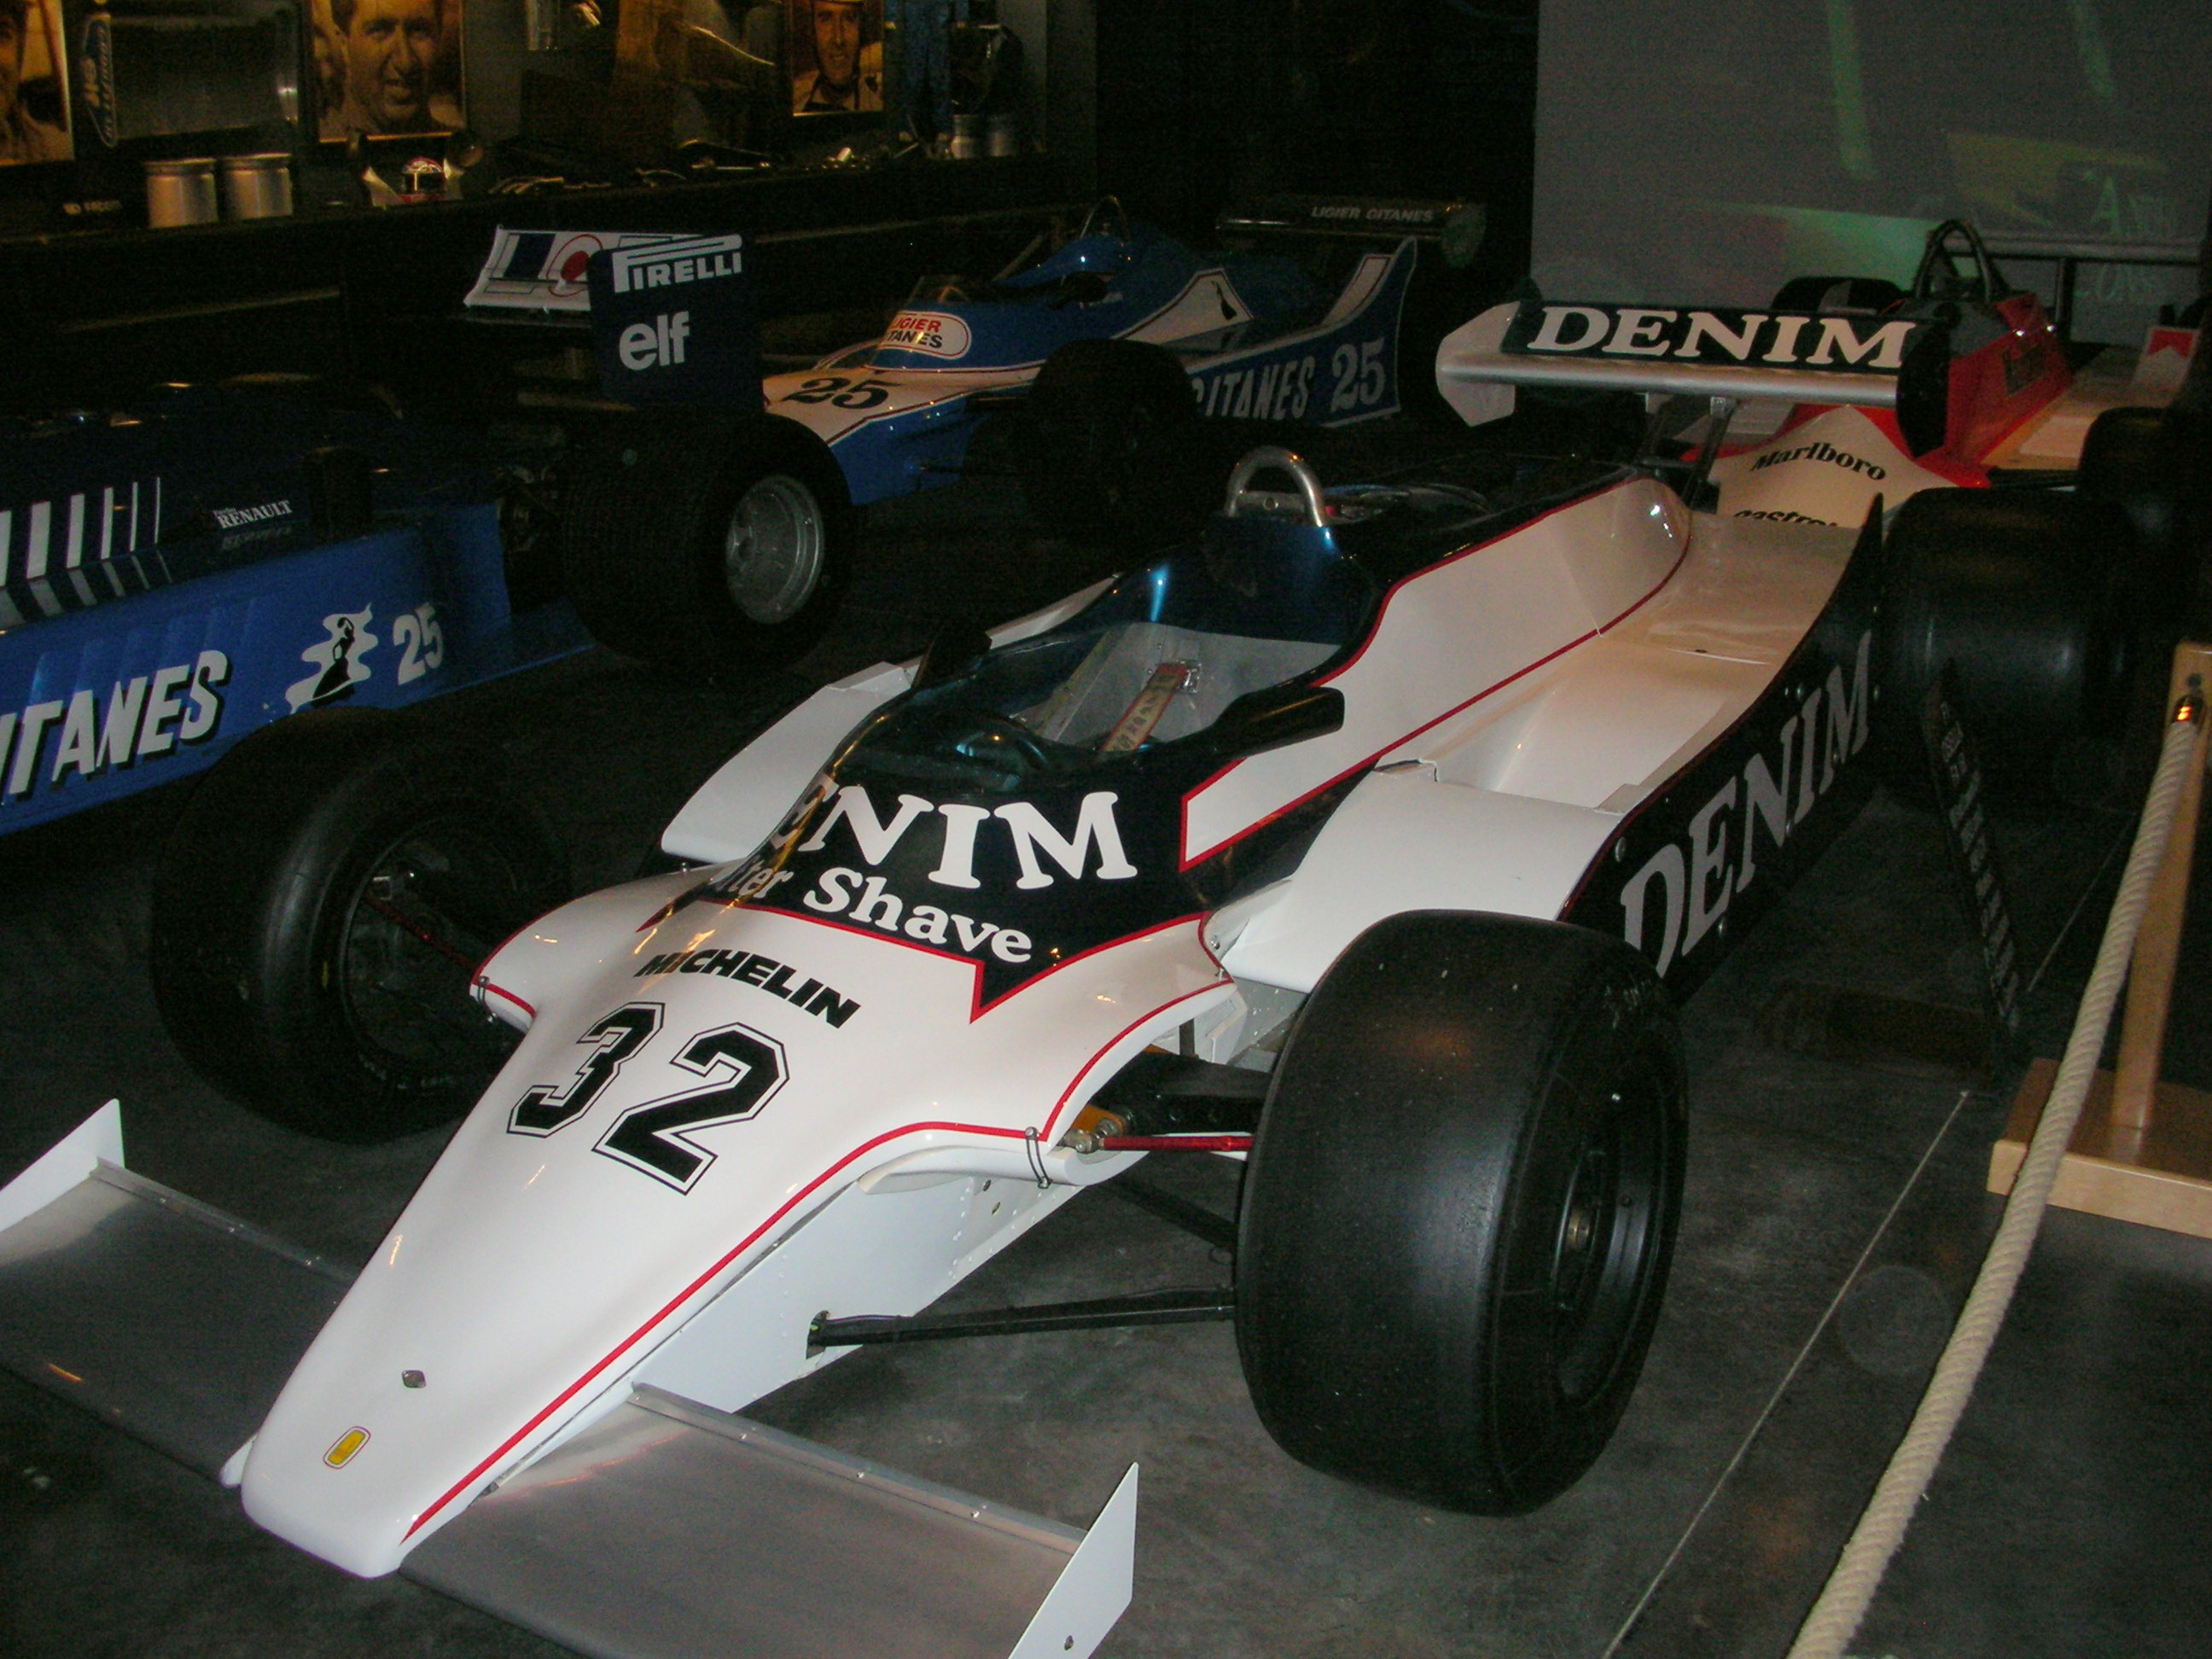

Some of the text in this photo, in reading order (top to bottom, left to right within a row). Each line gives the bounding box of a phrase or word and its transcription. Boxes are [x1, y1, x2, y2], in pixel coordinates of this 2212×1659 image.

[1311, 206, 1435, 223] LIGIER GITANES
[611, 233, 742, 294] PIRELLI
[618, 311, 690, 371] elf
[887, 329, 943, 349] TANES
[1526, 305, 1918, 369] DENIM
[780, 376, 901, 410] 25
[1330, 338, 1387, 413] 25
[1749, 441, 1886, 480] Marlboro
[216, 499, 294, 529] RENAULT
[0, 601, 444, 796] TANES 25
[1620, 628, 1872, 979] DENIM
[712, 855, 1033, 963] ter Shave
[633, 948, 862, 1029] MICHELIN
[506, 1001, 790, 1196] 32
